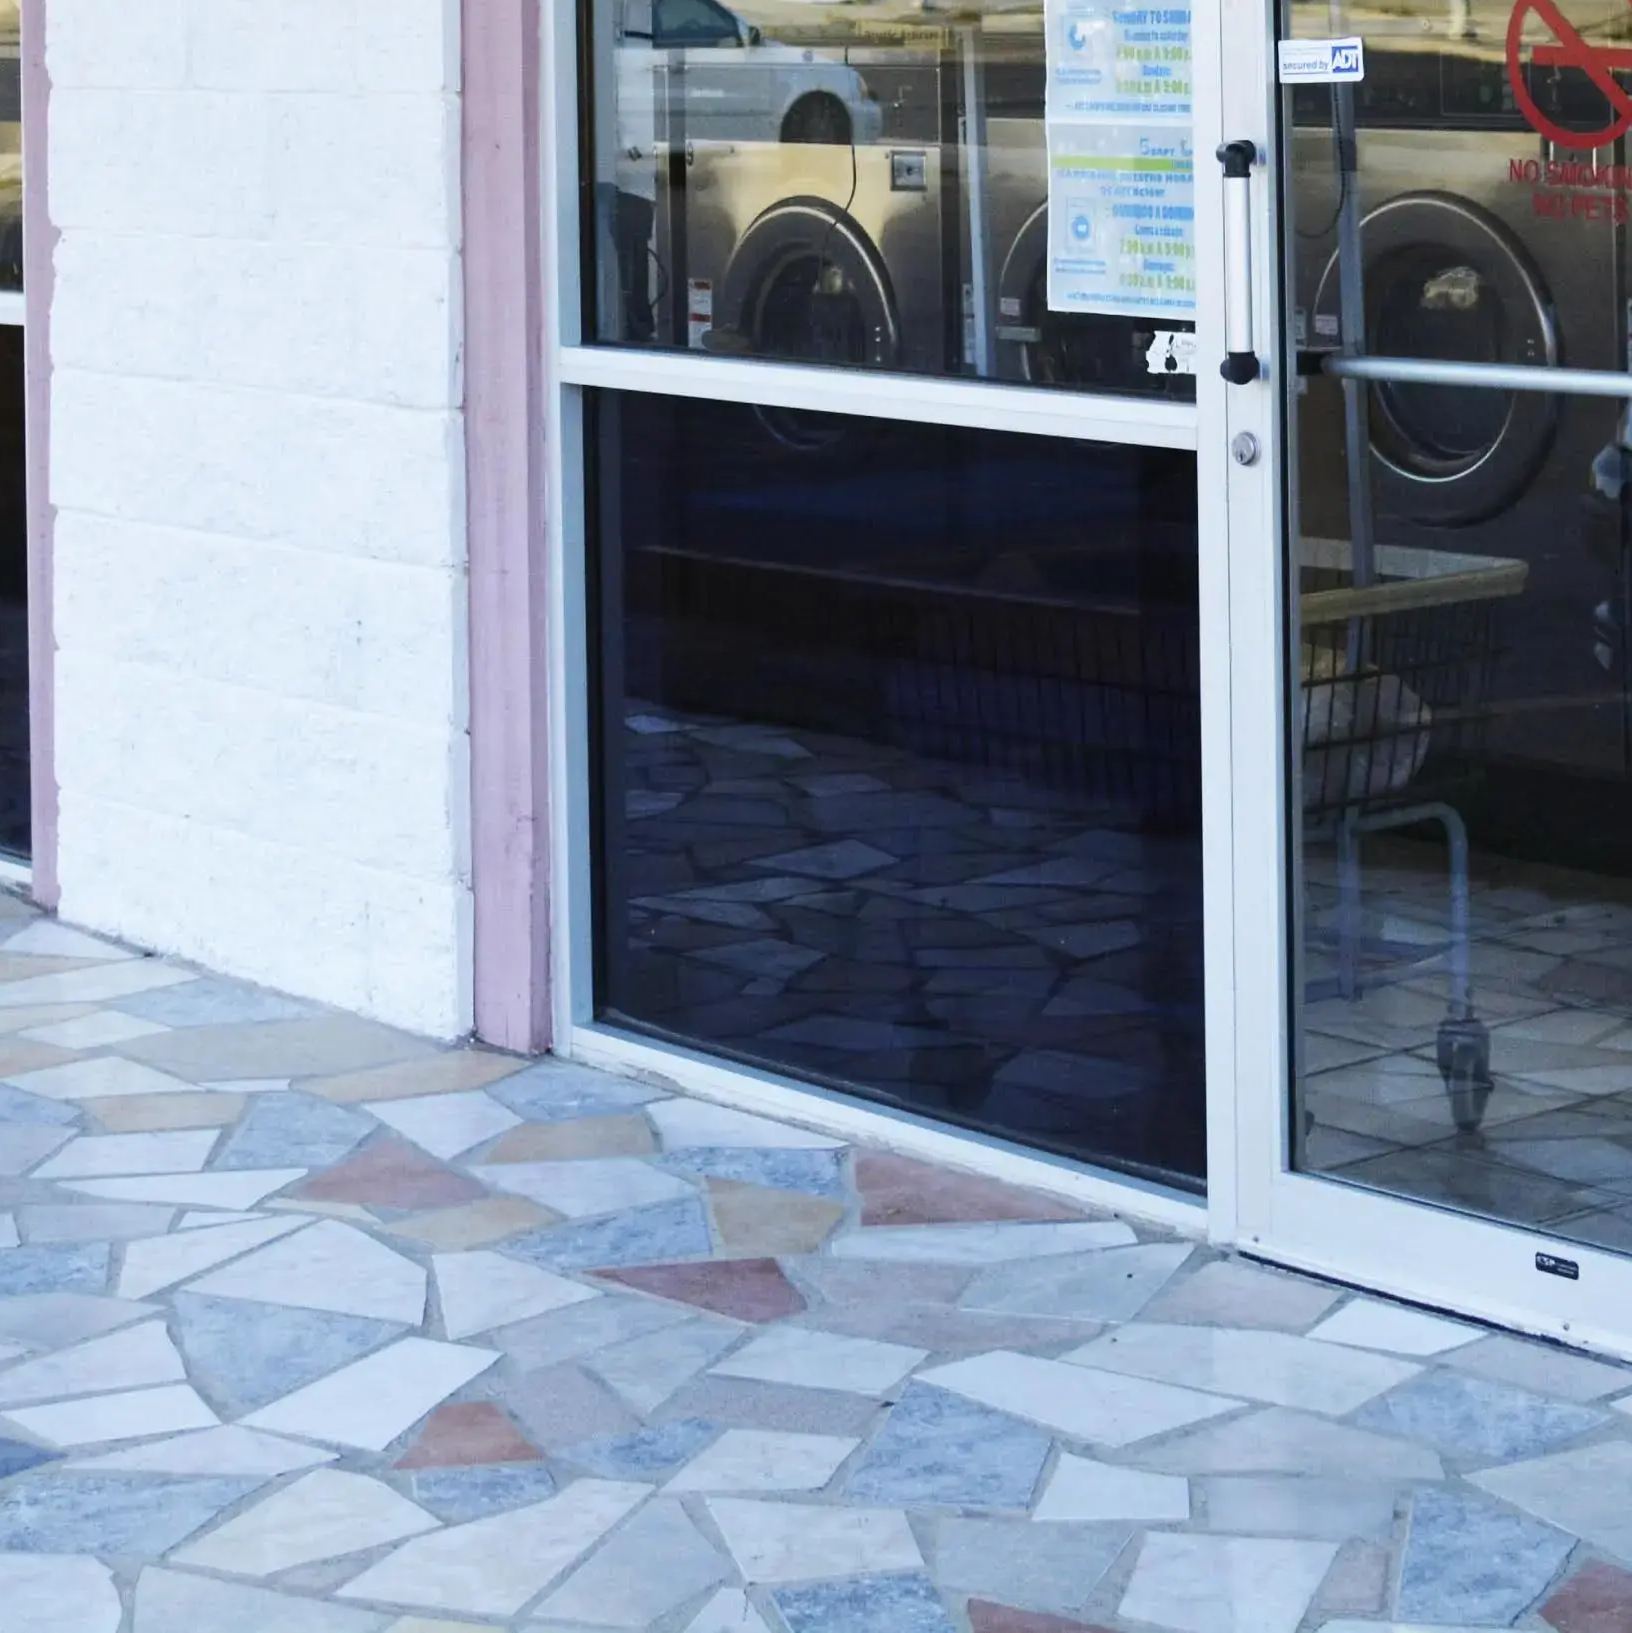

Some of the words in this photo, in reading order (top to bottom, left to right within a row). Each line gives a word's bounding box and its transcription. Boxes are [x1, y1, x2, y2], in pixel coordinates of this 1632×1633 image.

[1283, 57, 1318, 69] secured
[1330, 47, 1358, 70] ADT
[1509, 158, 1539, 183] NO
